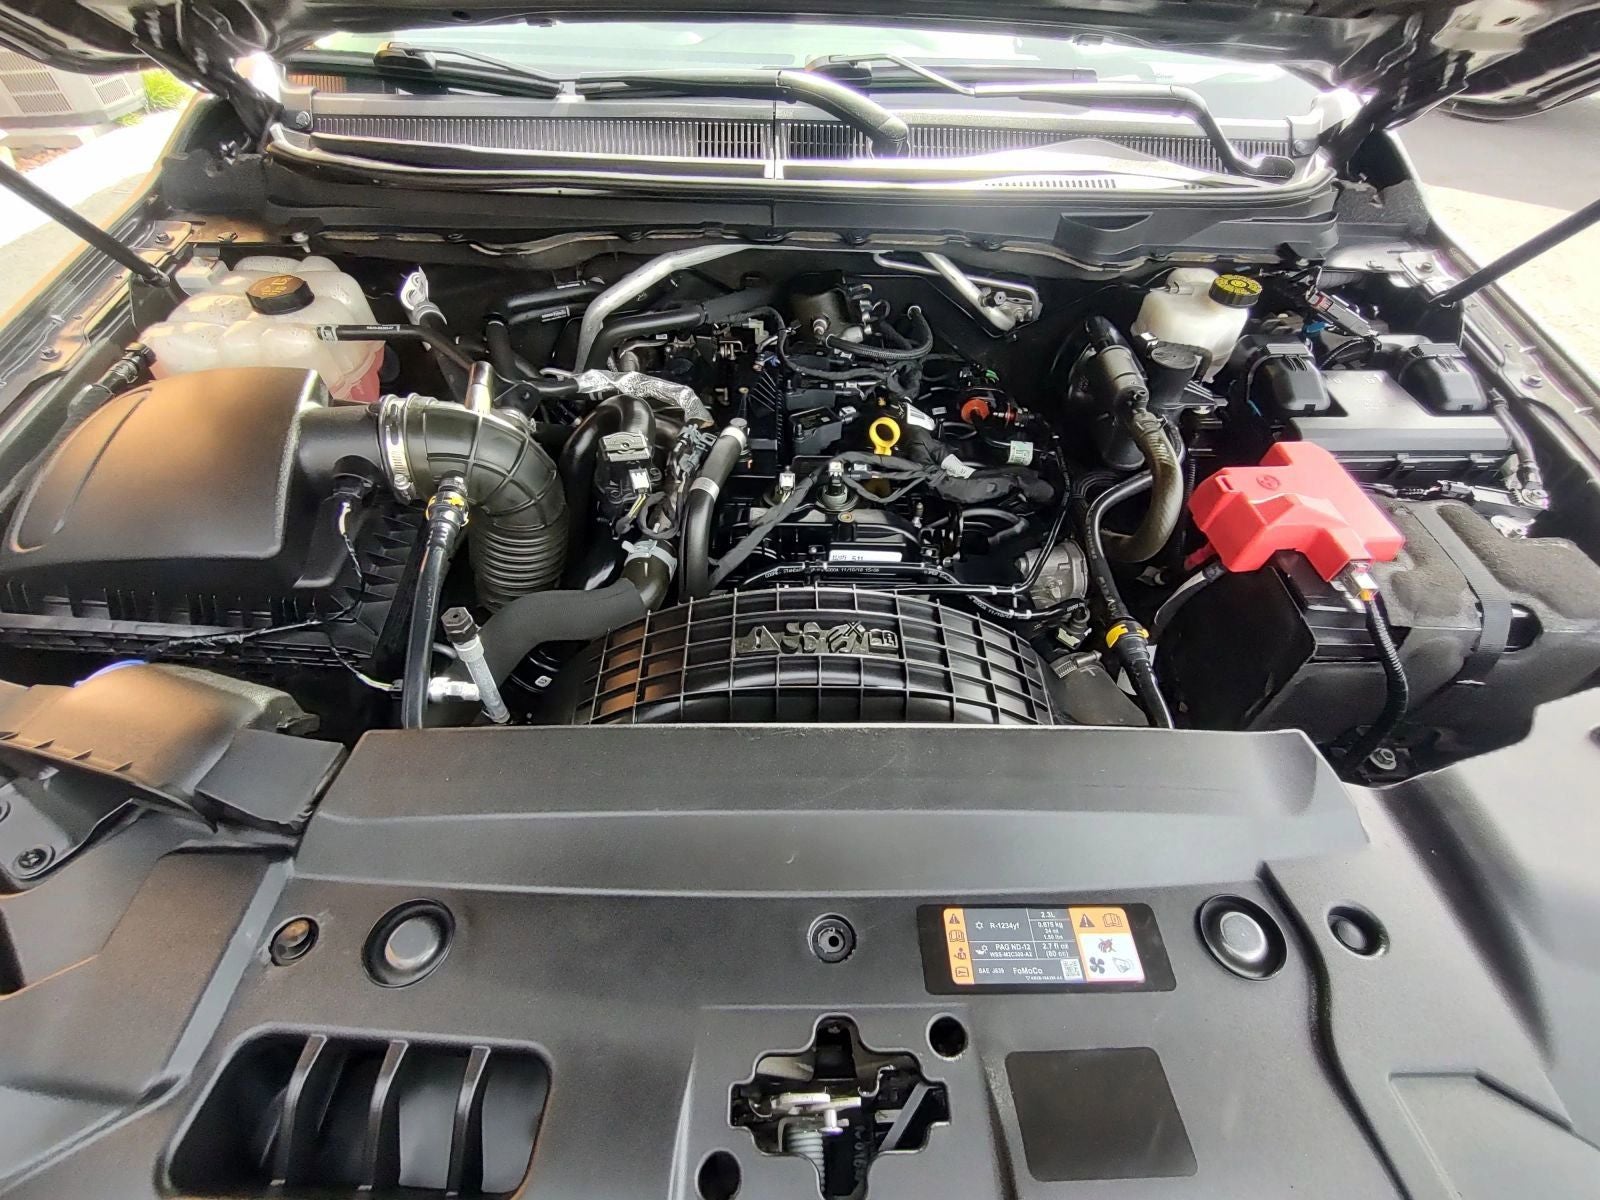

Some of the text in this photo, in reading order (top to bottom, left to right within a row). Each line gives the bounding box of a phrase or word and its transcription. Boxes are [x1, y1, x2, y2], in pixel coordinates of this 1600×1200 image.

[1040, 911, 1056, 919] 2.3L
[989, 921, 1020, 931] R-1234yf
[995, 943, 1031, 951] PAG ND-12
[1012, 966, 1043, 975] FoMoCo
